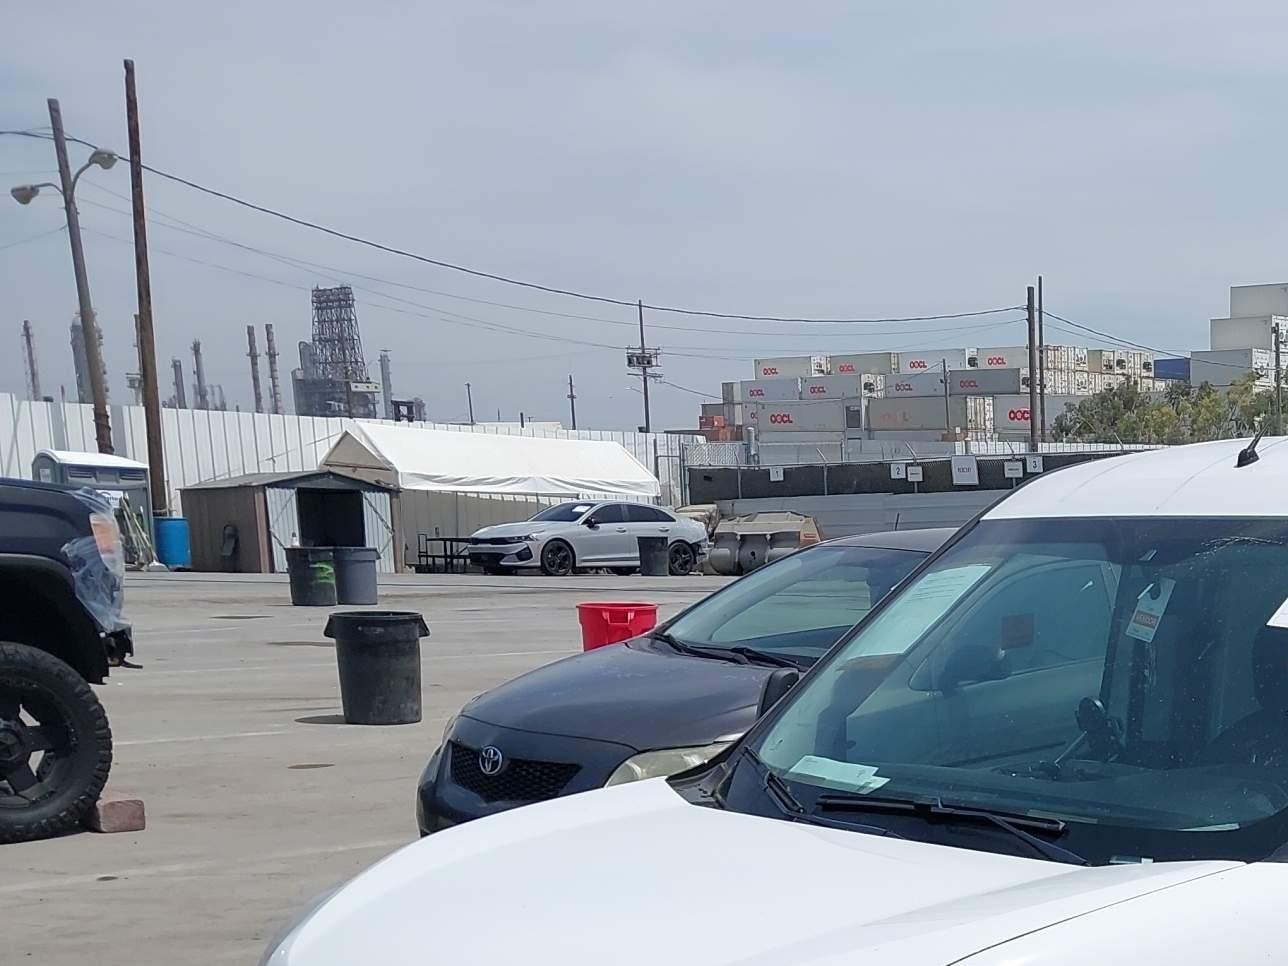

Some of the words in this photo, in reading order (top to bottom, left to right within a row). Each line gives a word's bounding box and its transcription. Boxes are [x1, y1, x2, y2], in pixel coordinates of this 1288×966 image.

[909, 360, 928, 369] OOCL
[988, 357, 1007, 365] OOCL
[769, 413, 793, 424] OOCL
[1008, 410, 1031, 421] OOC
[1032, 461, 1038, 469] 3
[895, 467, 901, 475] 2
